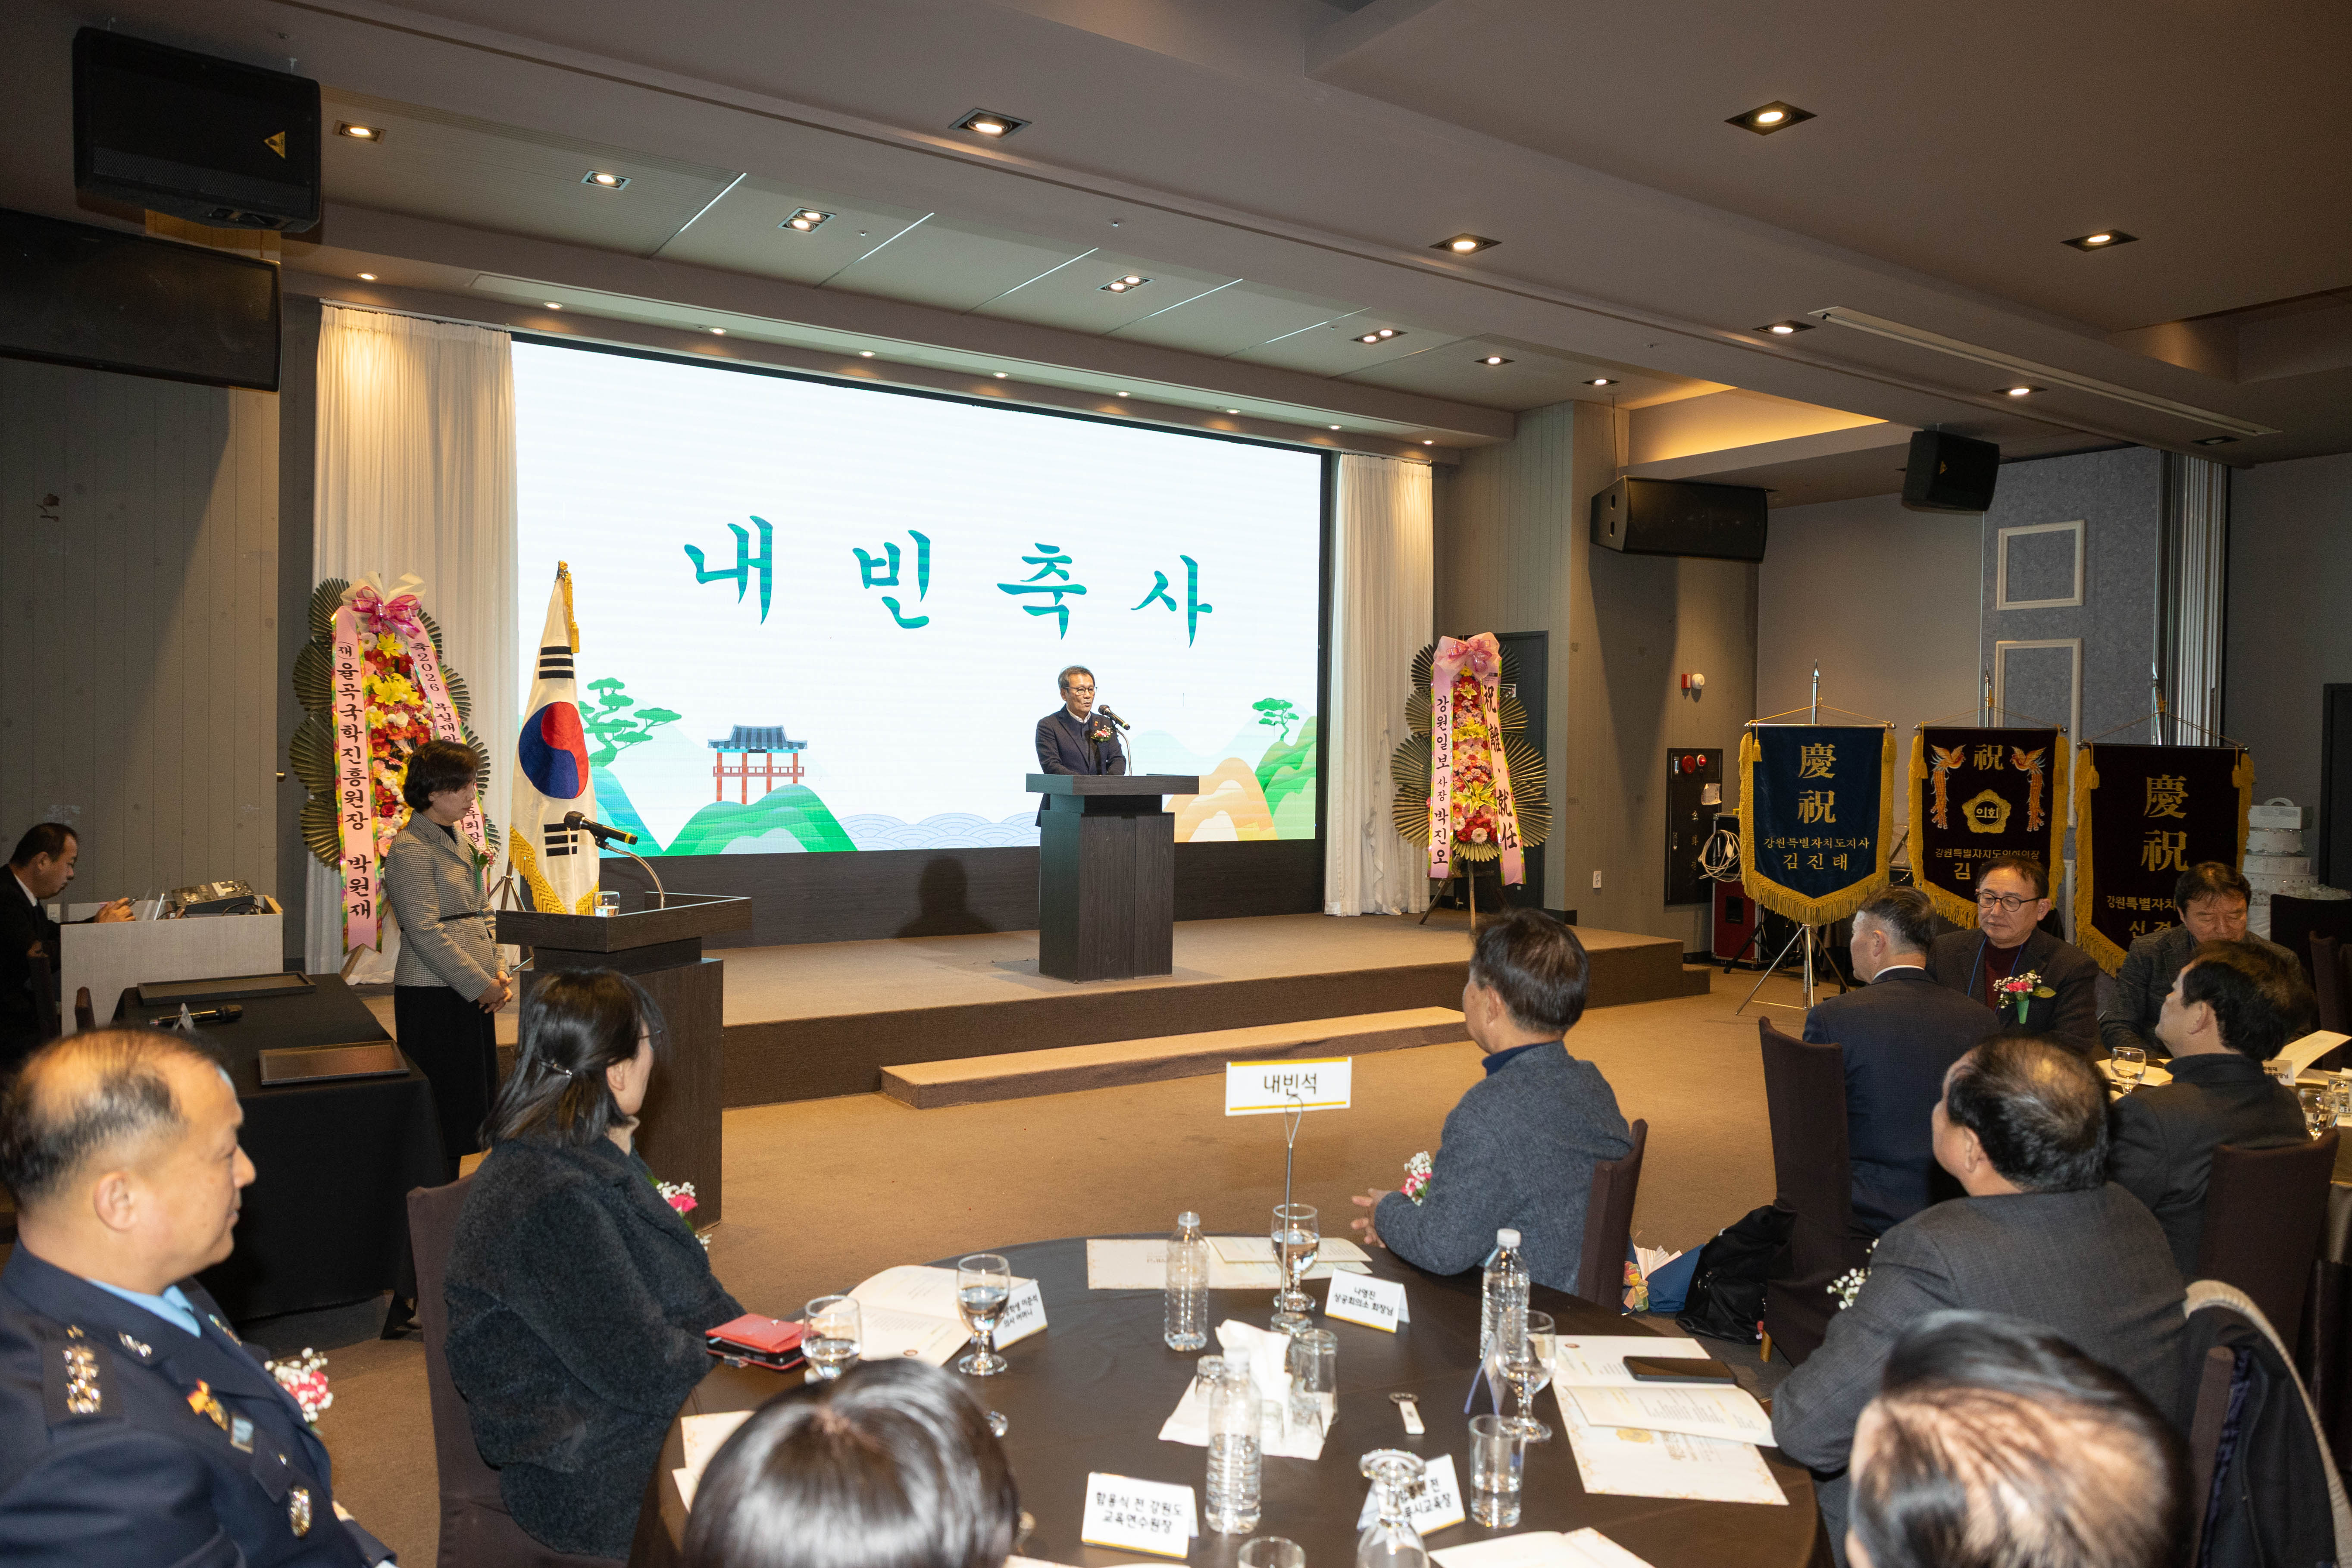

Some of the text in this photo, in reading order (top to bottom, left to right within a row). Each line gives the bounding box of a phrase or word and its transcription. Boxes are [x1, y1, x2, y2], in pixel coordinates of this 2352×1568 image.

[1973, 744, 2004, 771] 祝
[1432, 695, 1450, 864] 강원일보 사장 박진오
[1976, 807, 2000, 819] 의회
[1763, 837, 1870, 850] 강원특별자치도지사
[347, 854, 372, 920] 박원재
[1264, 1072, 1317, 1096] 내빈석
[1103, 1510, 1172, 1534] 교육연수원장
